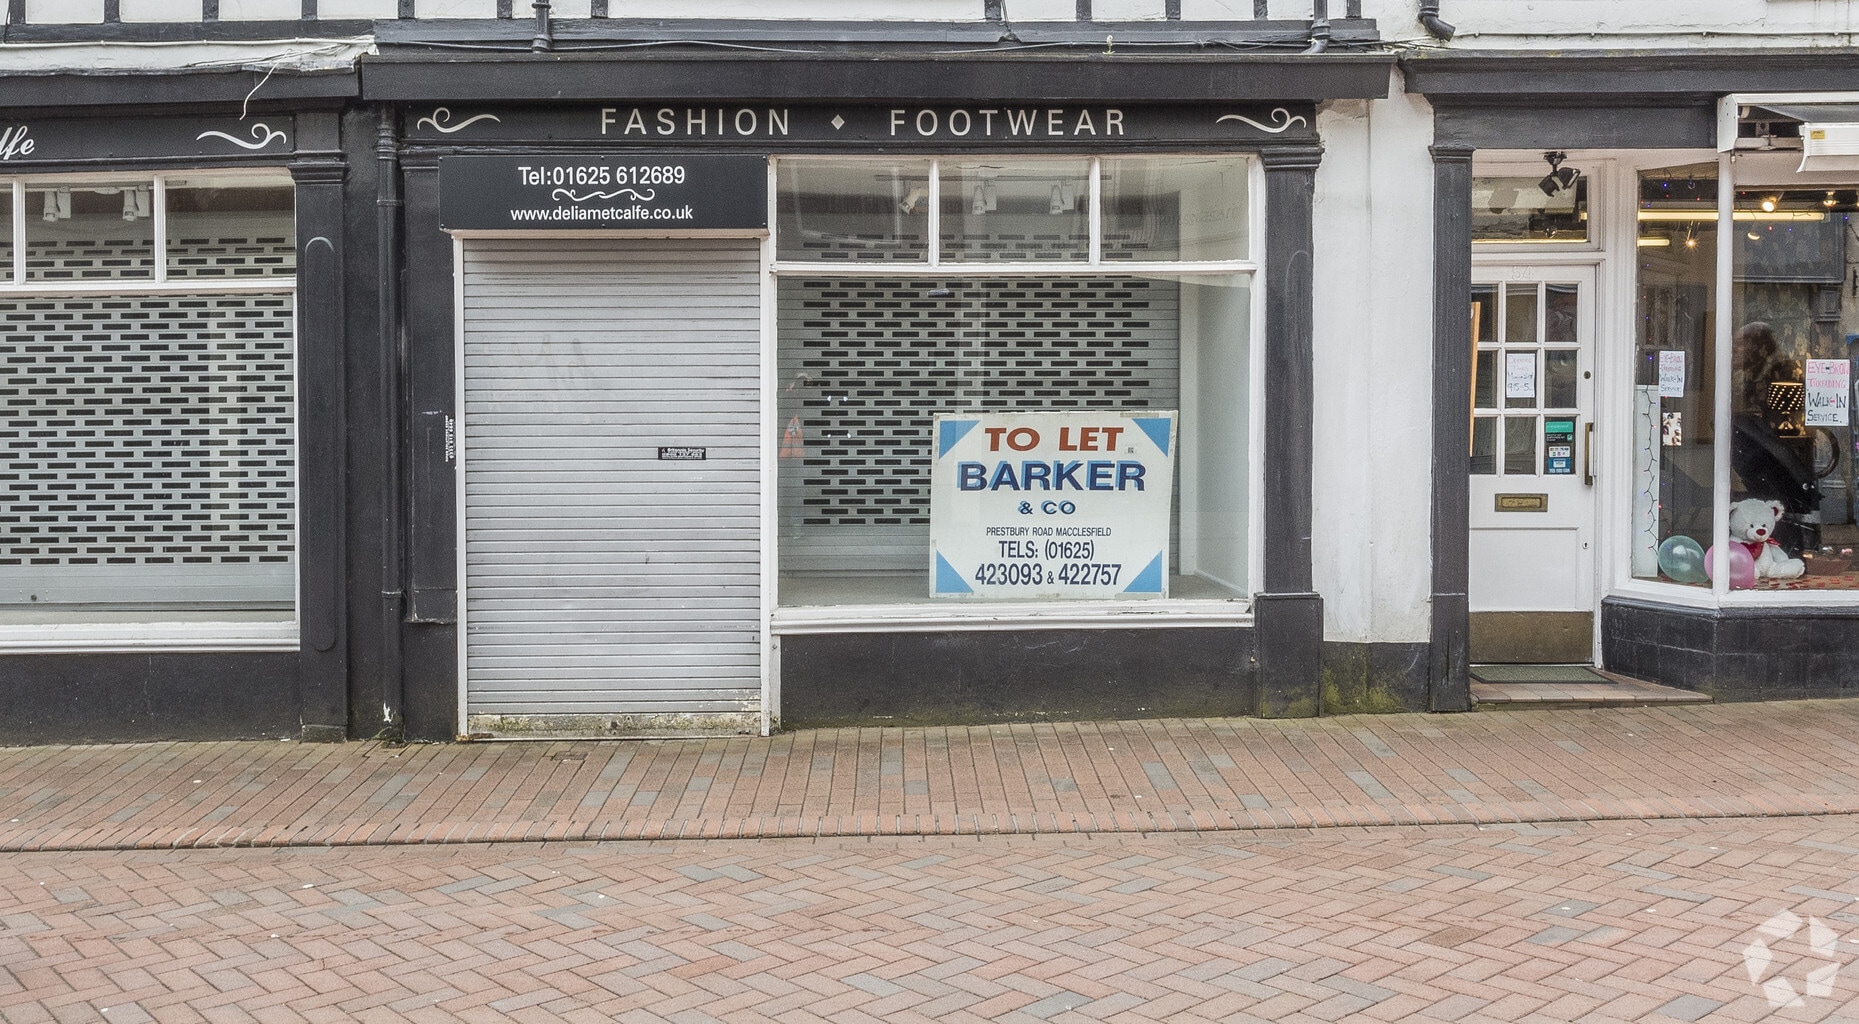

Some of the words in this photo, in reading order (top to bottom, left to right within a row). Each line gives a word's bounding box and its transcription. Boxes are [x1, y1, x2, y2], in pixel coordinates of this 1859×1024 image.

[599, 108, 788, 136] FASHION
[890, 109, 1124, 136] FOOTWEAR
[517, 166, 611, 185] Tel:01625
[616, 166, 686, 184] 612689
[510, 205, 693, 221] www.deliametcalfe.co.uk
[1808, 392, 1847, 408] WALK-IN
[985, 427, 1041, 452] TO
[1059, 427, 1124, 452] LET
[957, 460, 1146, 491] BARKER
[1017, 501, 1034, 515] &
[1040, 500, 1077, 515] CO
[986, 527, 1029, 537] PRESTBURY
[1032, 527, 1053, 537] ROAD
[1055, 527, 1112, 537] MACCLESFIELD
[998, 540, 1039, 559] TELS:
[1044, 539, 1095, 561] (01625)
[975, 563, 1043, 585] 423093
[1046, 570, 1055, 585] &
[1058, 563, 1122, 586] 422757
